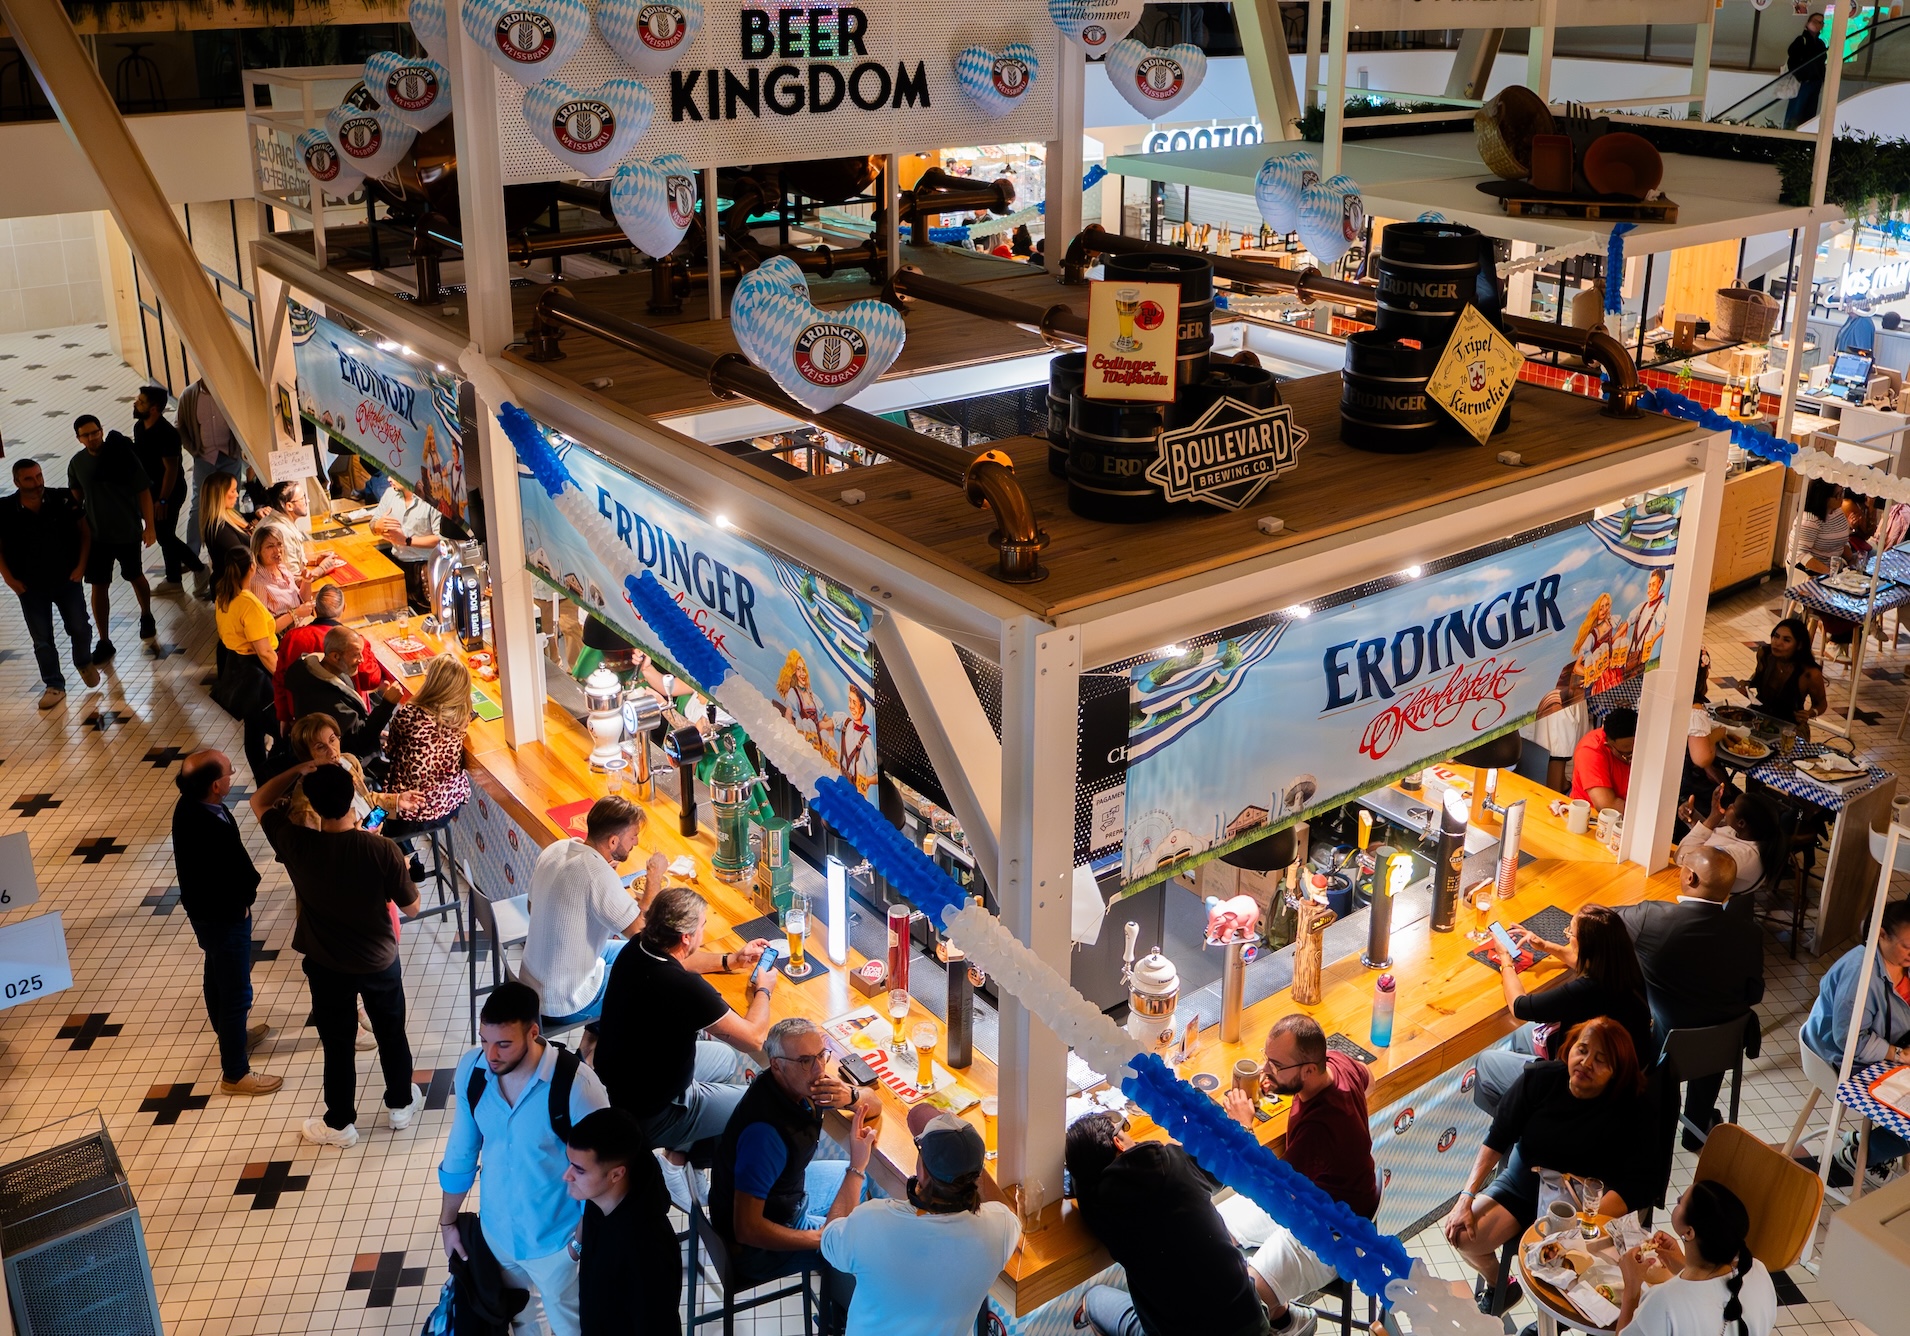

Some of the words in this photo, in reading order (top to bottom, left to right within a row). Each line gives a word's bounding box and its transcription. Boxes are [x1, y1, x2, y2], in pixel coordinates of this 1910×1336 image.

[500, 13, 552, 36] ERDINGER
[640, 5, 682, 23] ERDINGER
[1060, 8, 1131, 21] Willkommen
[741, 6, 869, 60] BEER
[389, 68, 434, 86] ERDINGER
[1139, 58, 1181, 76] ERDINGER
[671, 61, 931, 122] KINGDOM
[557, 102, 611, 123] ERDINGER
[342, 118, 378, 135] ERDINGER
[1381, 275, 1459, 300] ERDINGER
[800, 325, 864, 351] ERDINGER
[1178, 321, 1204, 340] GER
[1452, 331, 1494, 363] Tripel
[1091, 353, 1157, 372] Erdinger
[330, 340, 419, 431] ERDINGER
[1460, 374, 1468, 386] 16
[1486, 366, 1495, 378] 79
[1350, 389, 1428, 412] ERDINGER
[1449, 377, 1511, 416] Karmeliet
[1171, 418, 1289, 487] BOULEVARD
[1199, 462, 1250, 488] BREWING
[1252, 457, 1271, 474] CO.
[595, 482, 766, 650] ERDINGER
[469, 588, 478, 612] BOCK
[471, 612, 480, 637] SUPER
[1321, 572, 1567, 714] ERDINGER
[1358, 656, 1527, 761] Oktoberfest
[5, 974, 43, 999] 025
